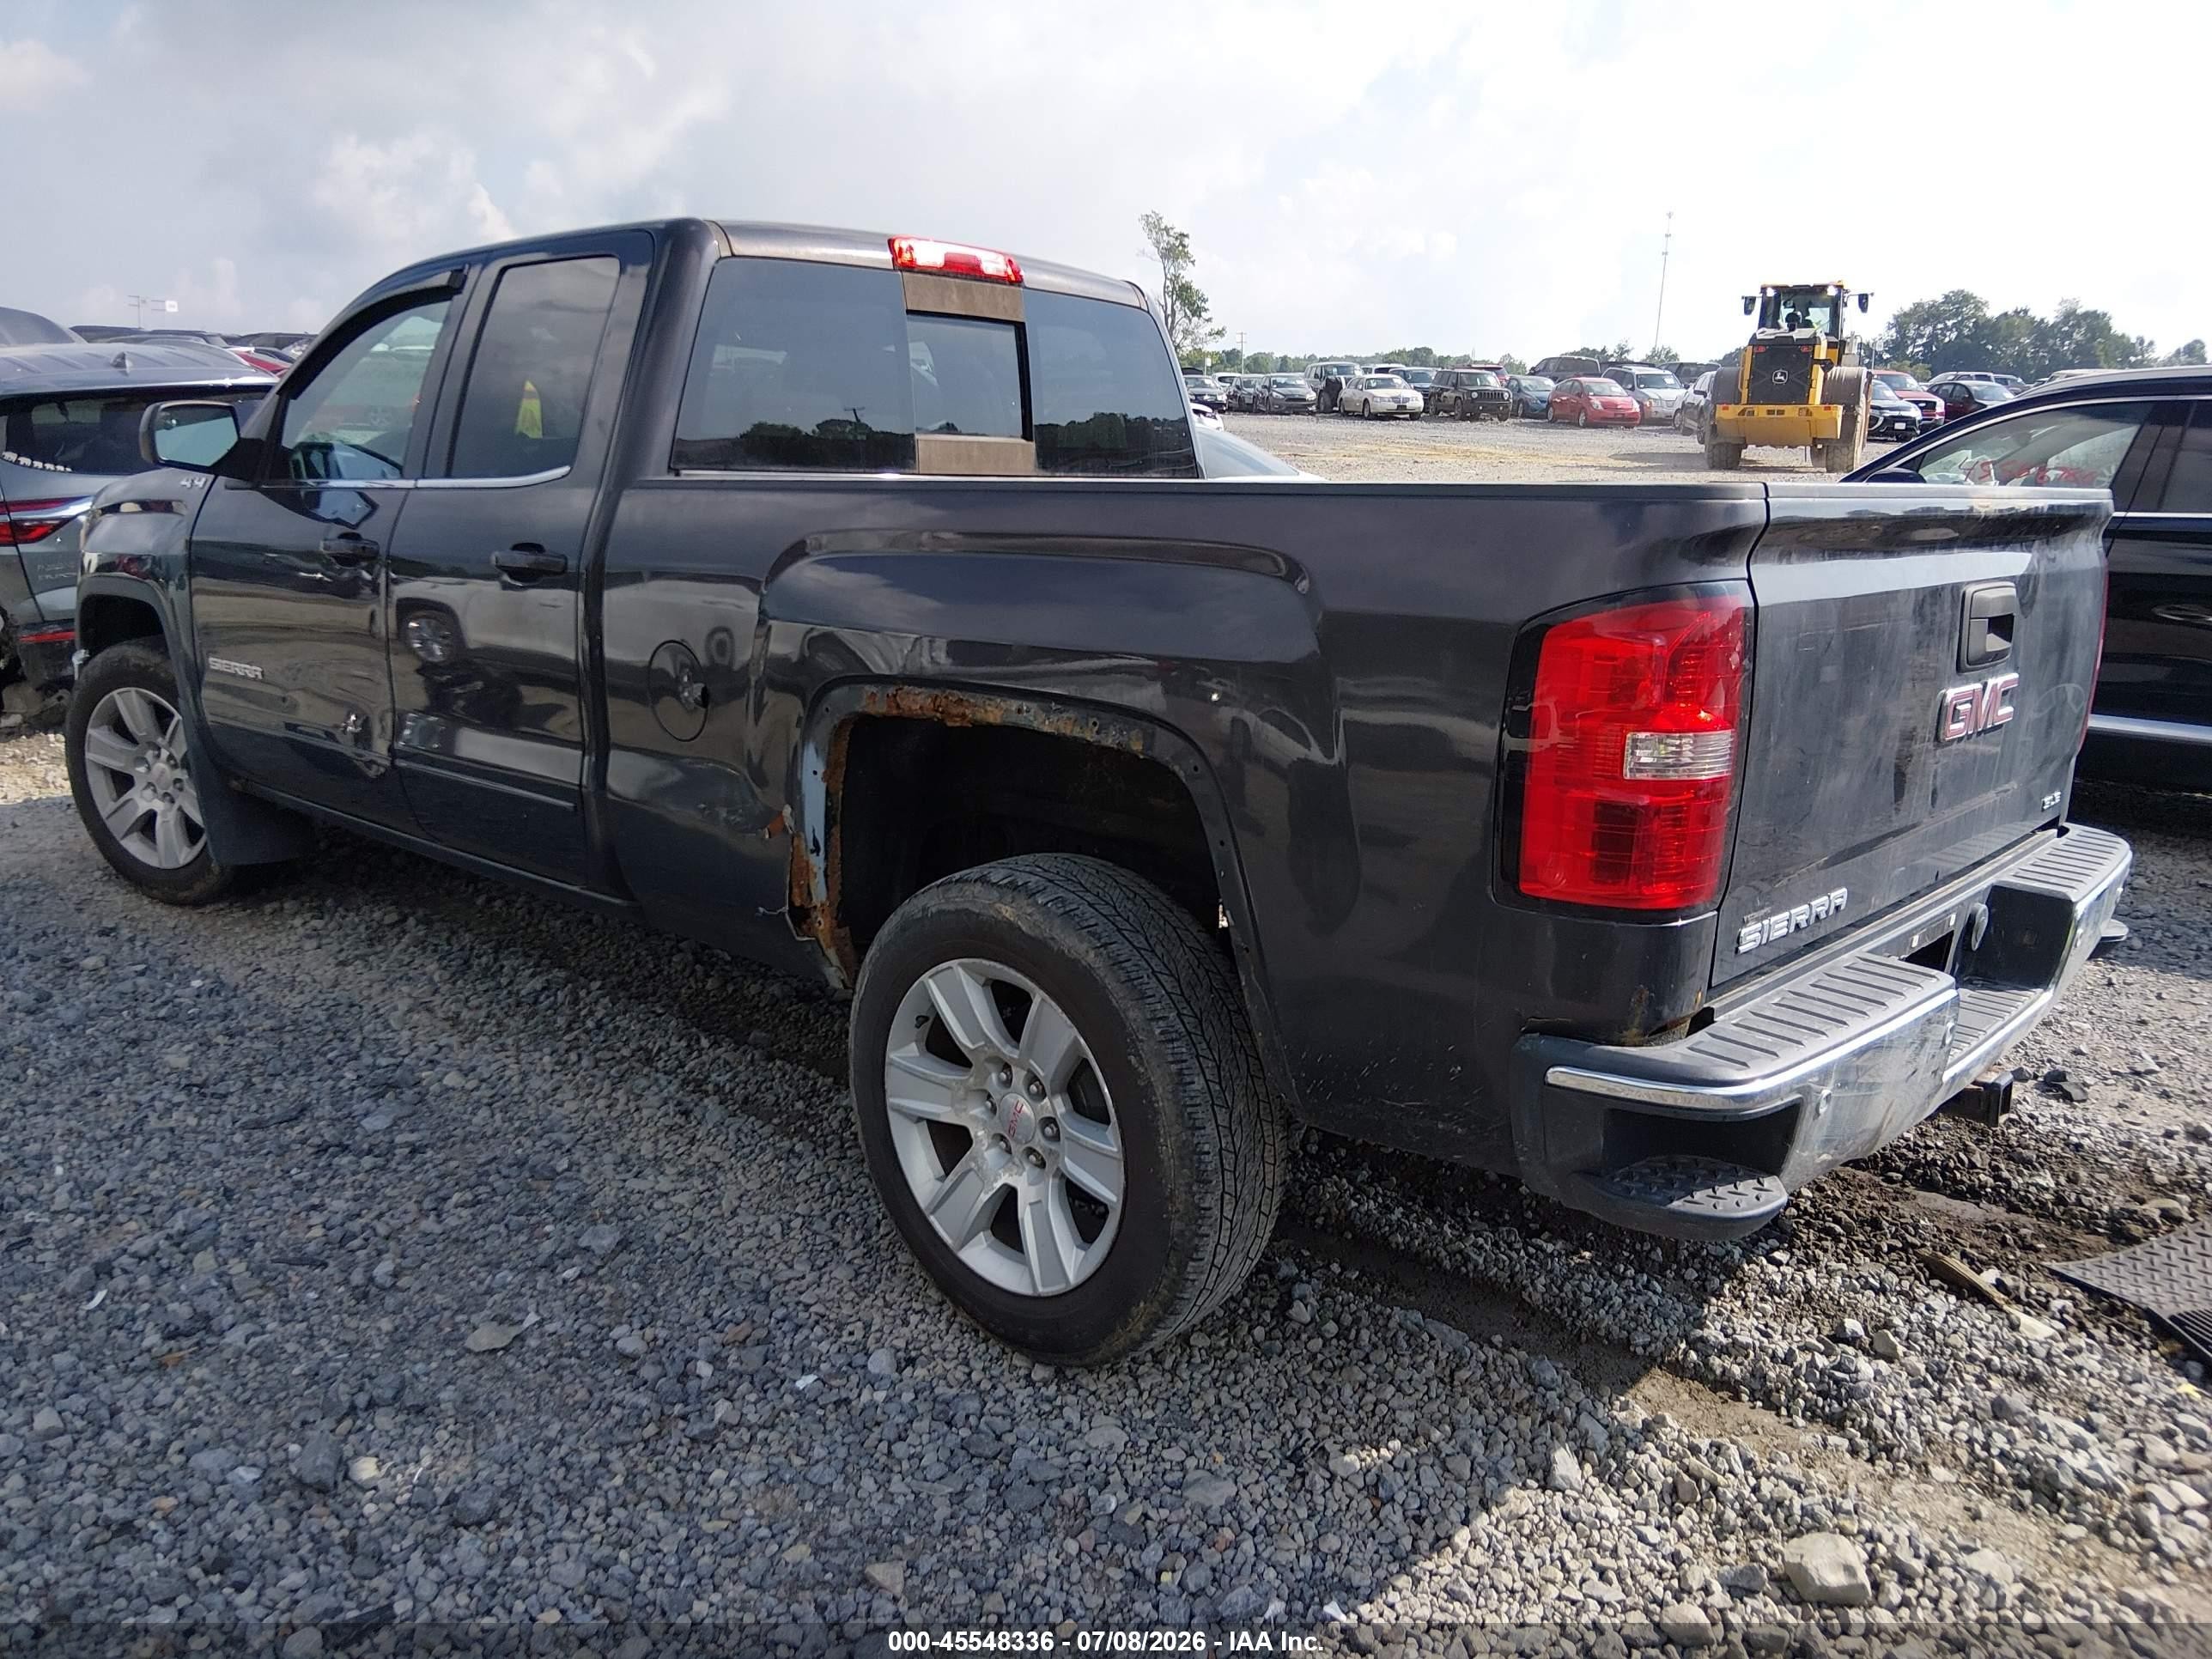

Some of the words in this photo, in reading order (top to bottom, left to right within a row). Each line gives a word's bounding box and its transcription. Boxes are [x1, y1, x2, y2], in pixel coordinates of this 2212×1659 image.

[208, 656, 263, 680] SIERRA
[1942, 672, 2020, 740] GMC
[1738, 887, 1848, 954] SIERRA
[1008, 1099, 1024, 1139] GMC
